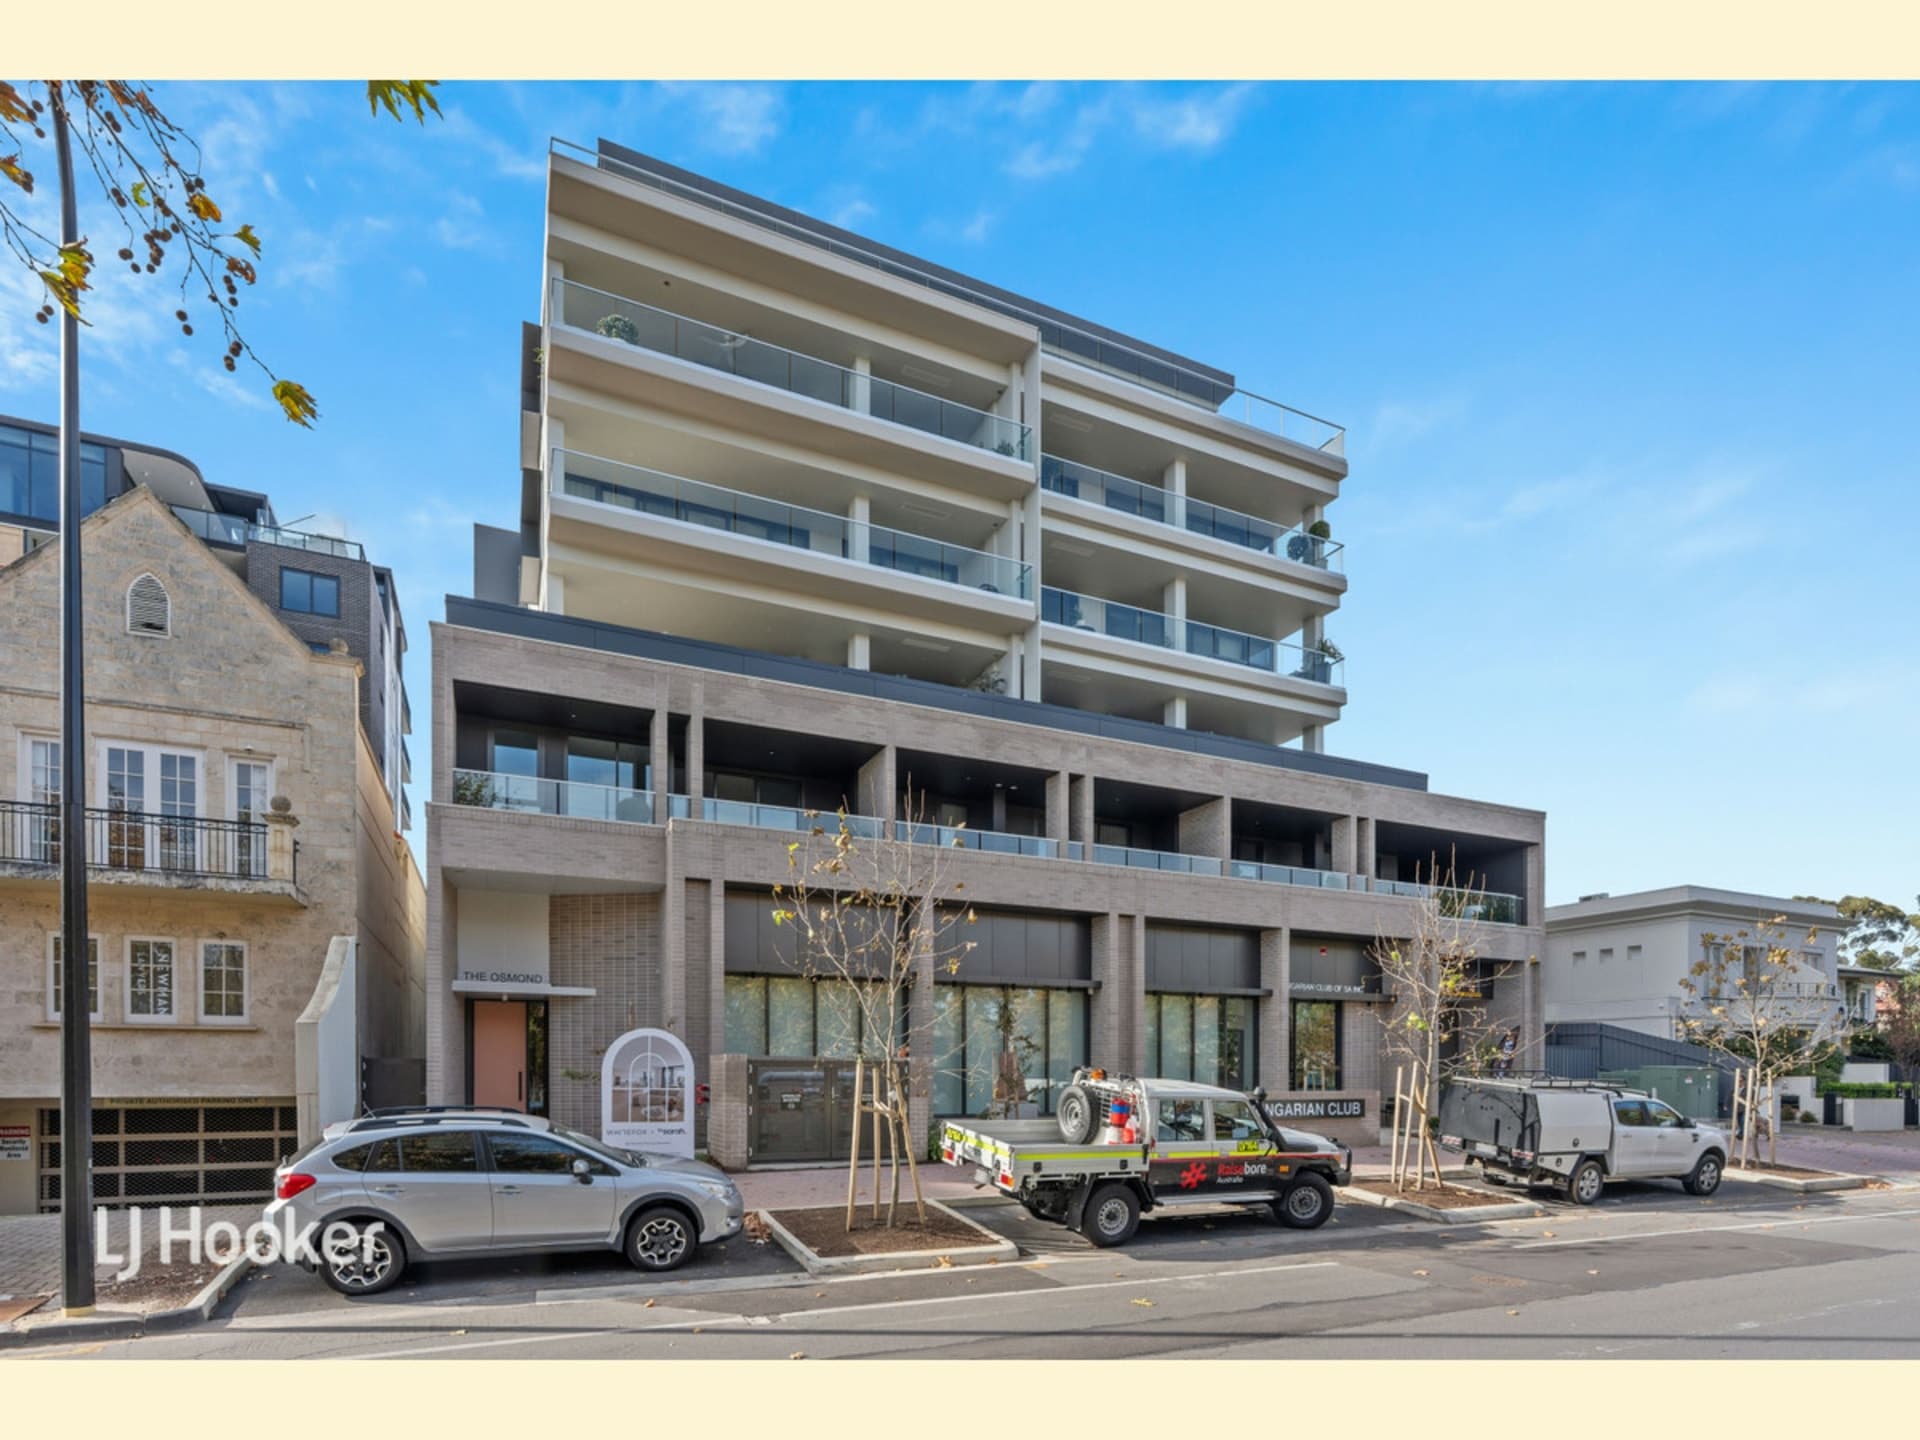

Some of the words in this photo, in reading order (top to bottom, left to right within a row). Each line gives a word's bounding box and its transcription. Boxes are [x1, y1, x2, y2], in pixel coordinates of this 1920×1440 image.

[157, 953, 170, 1014] NEWMAN
[463, 971, 487, 981] THE
[490, 972, 543, 984] OSMOND
[1288, 982, 1314, 991] GARIAN
[1315, 984, 1332, 992] CLUB
[1334, 984, 1342, 992] OF
[109, 1097, 145, 1105] PRIVATE
[200, 1097, 236, 1105] PARKING
[238, 1096, 259, 1104] ONLY
[1264, 1102, 1324, 1117] NGARIAN
[1327, 1101, 1361, 1116] CLUB
[1216, 1160, 1267, 1176] Raisebore
[1215, 1176, 1244, 1185] Australia
